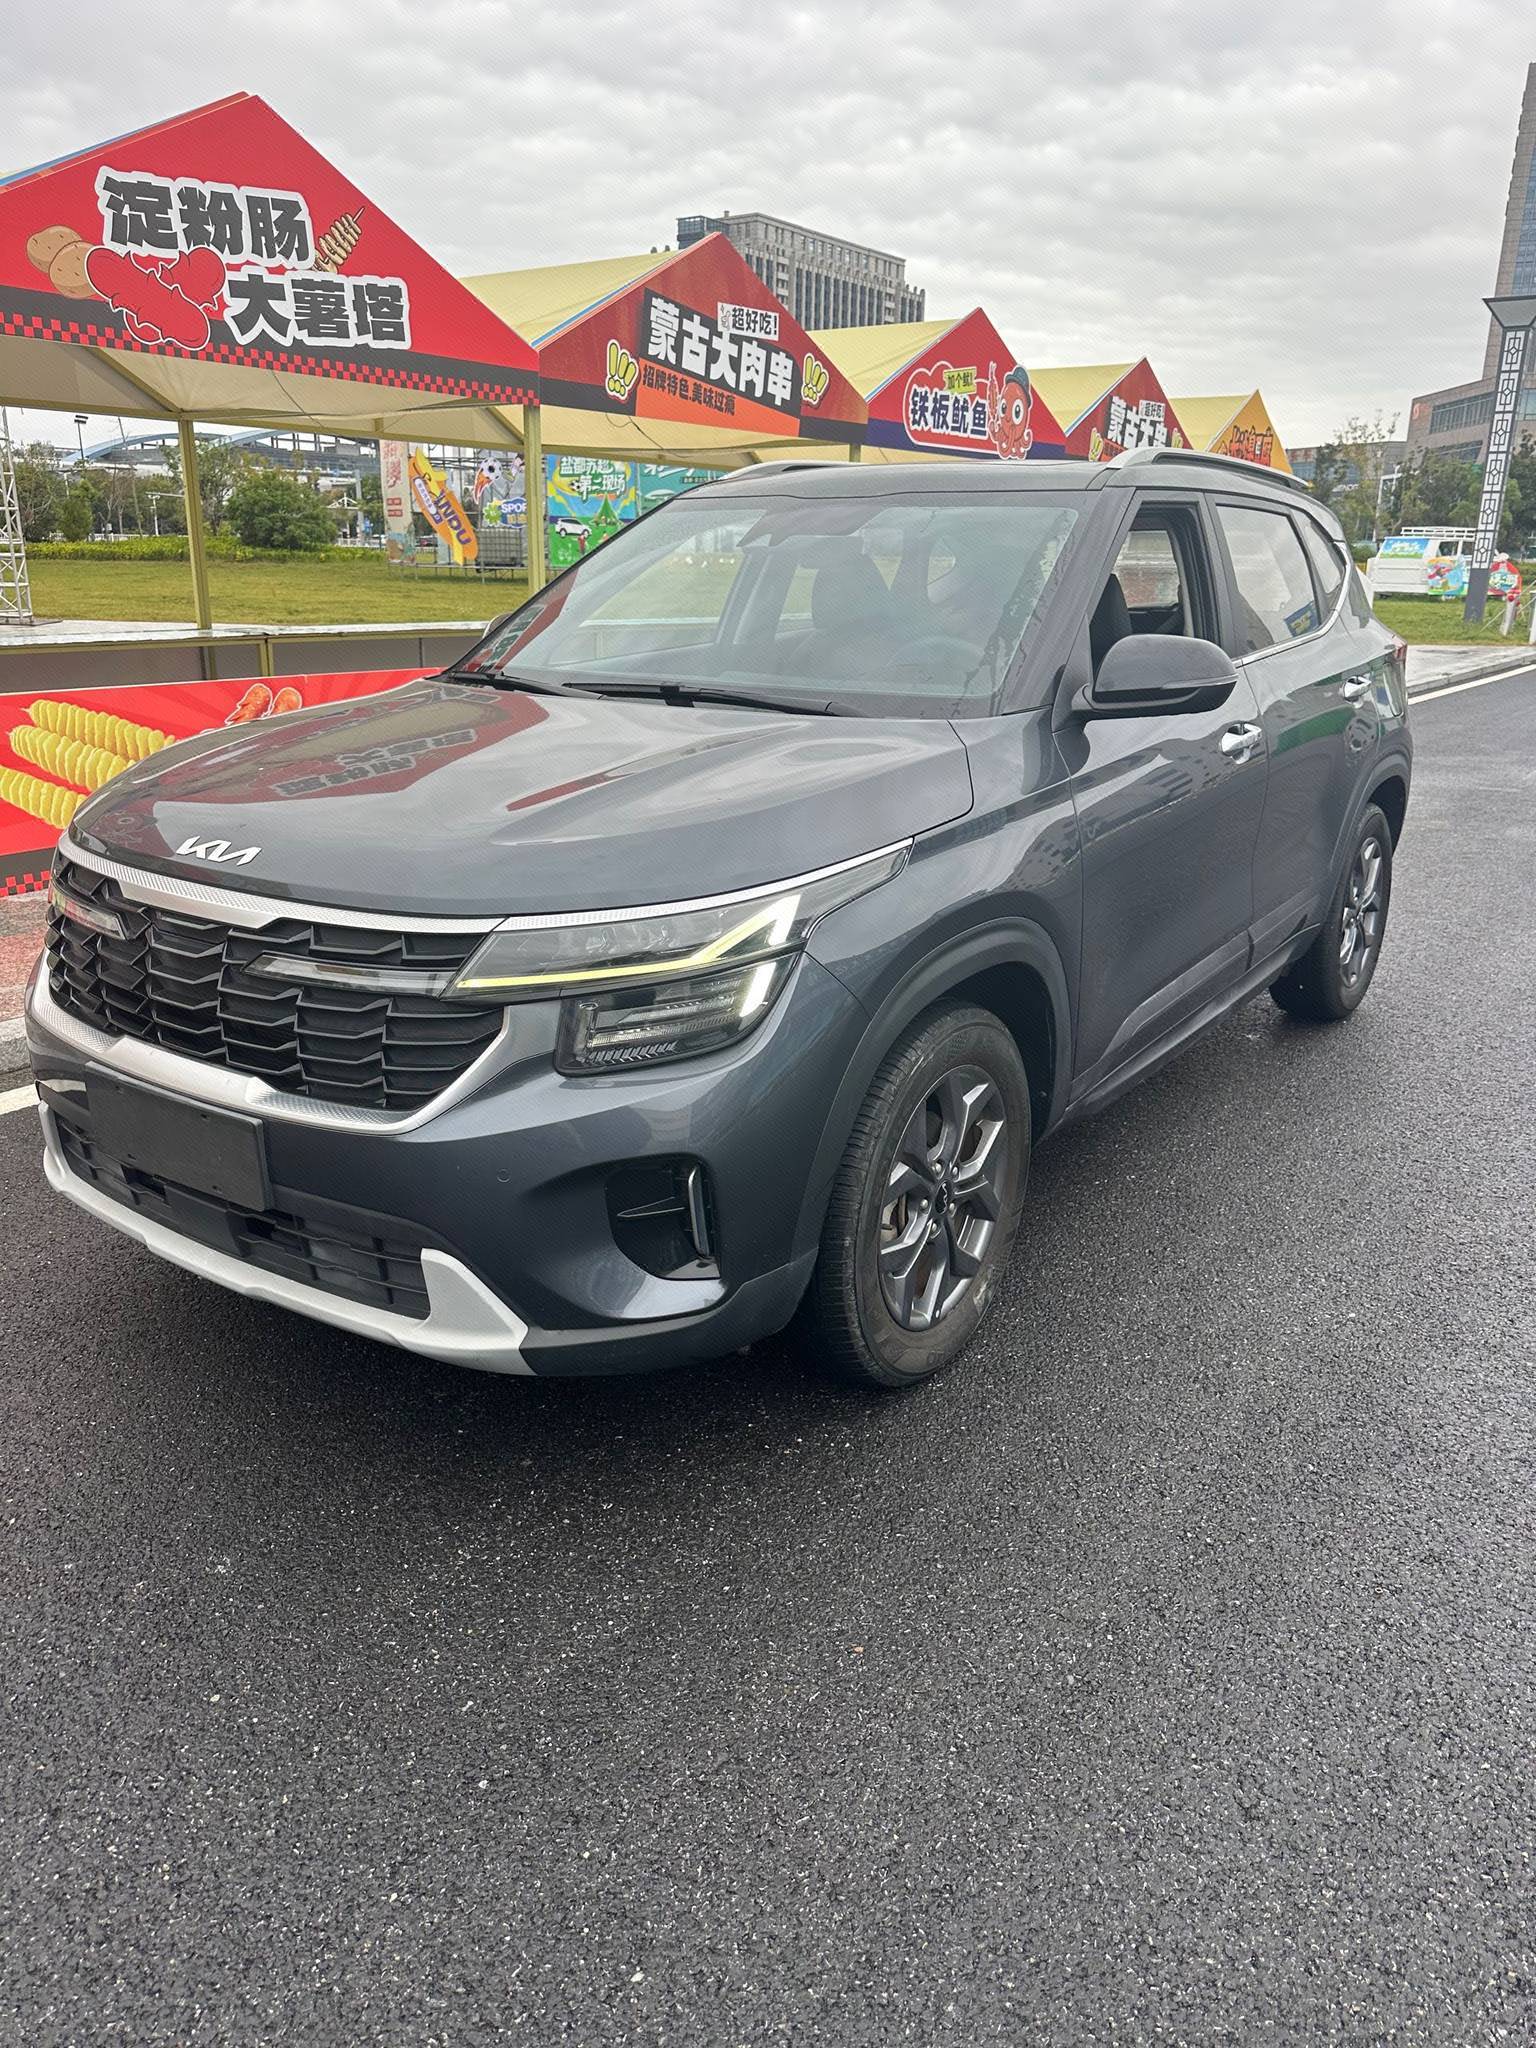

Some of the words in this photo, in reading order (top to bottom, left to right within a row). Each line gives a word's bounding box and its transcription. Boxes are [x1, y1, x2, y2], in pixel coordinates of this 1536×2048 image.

[103, 176, 309, 262] 淀粉肠
[228, 273, 406, 341] 大薯塔
[732, 307, 778, 335] 超好吃!
[648, 297, 793, 406] 蒙古大肉串
[911, 388, 986, 436] 铁板鱿鱼
[176, 836, 262, 866] KIA
